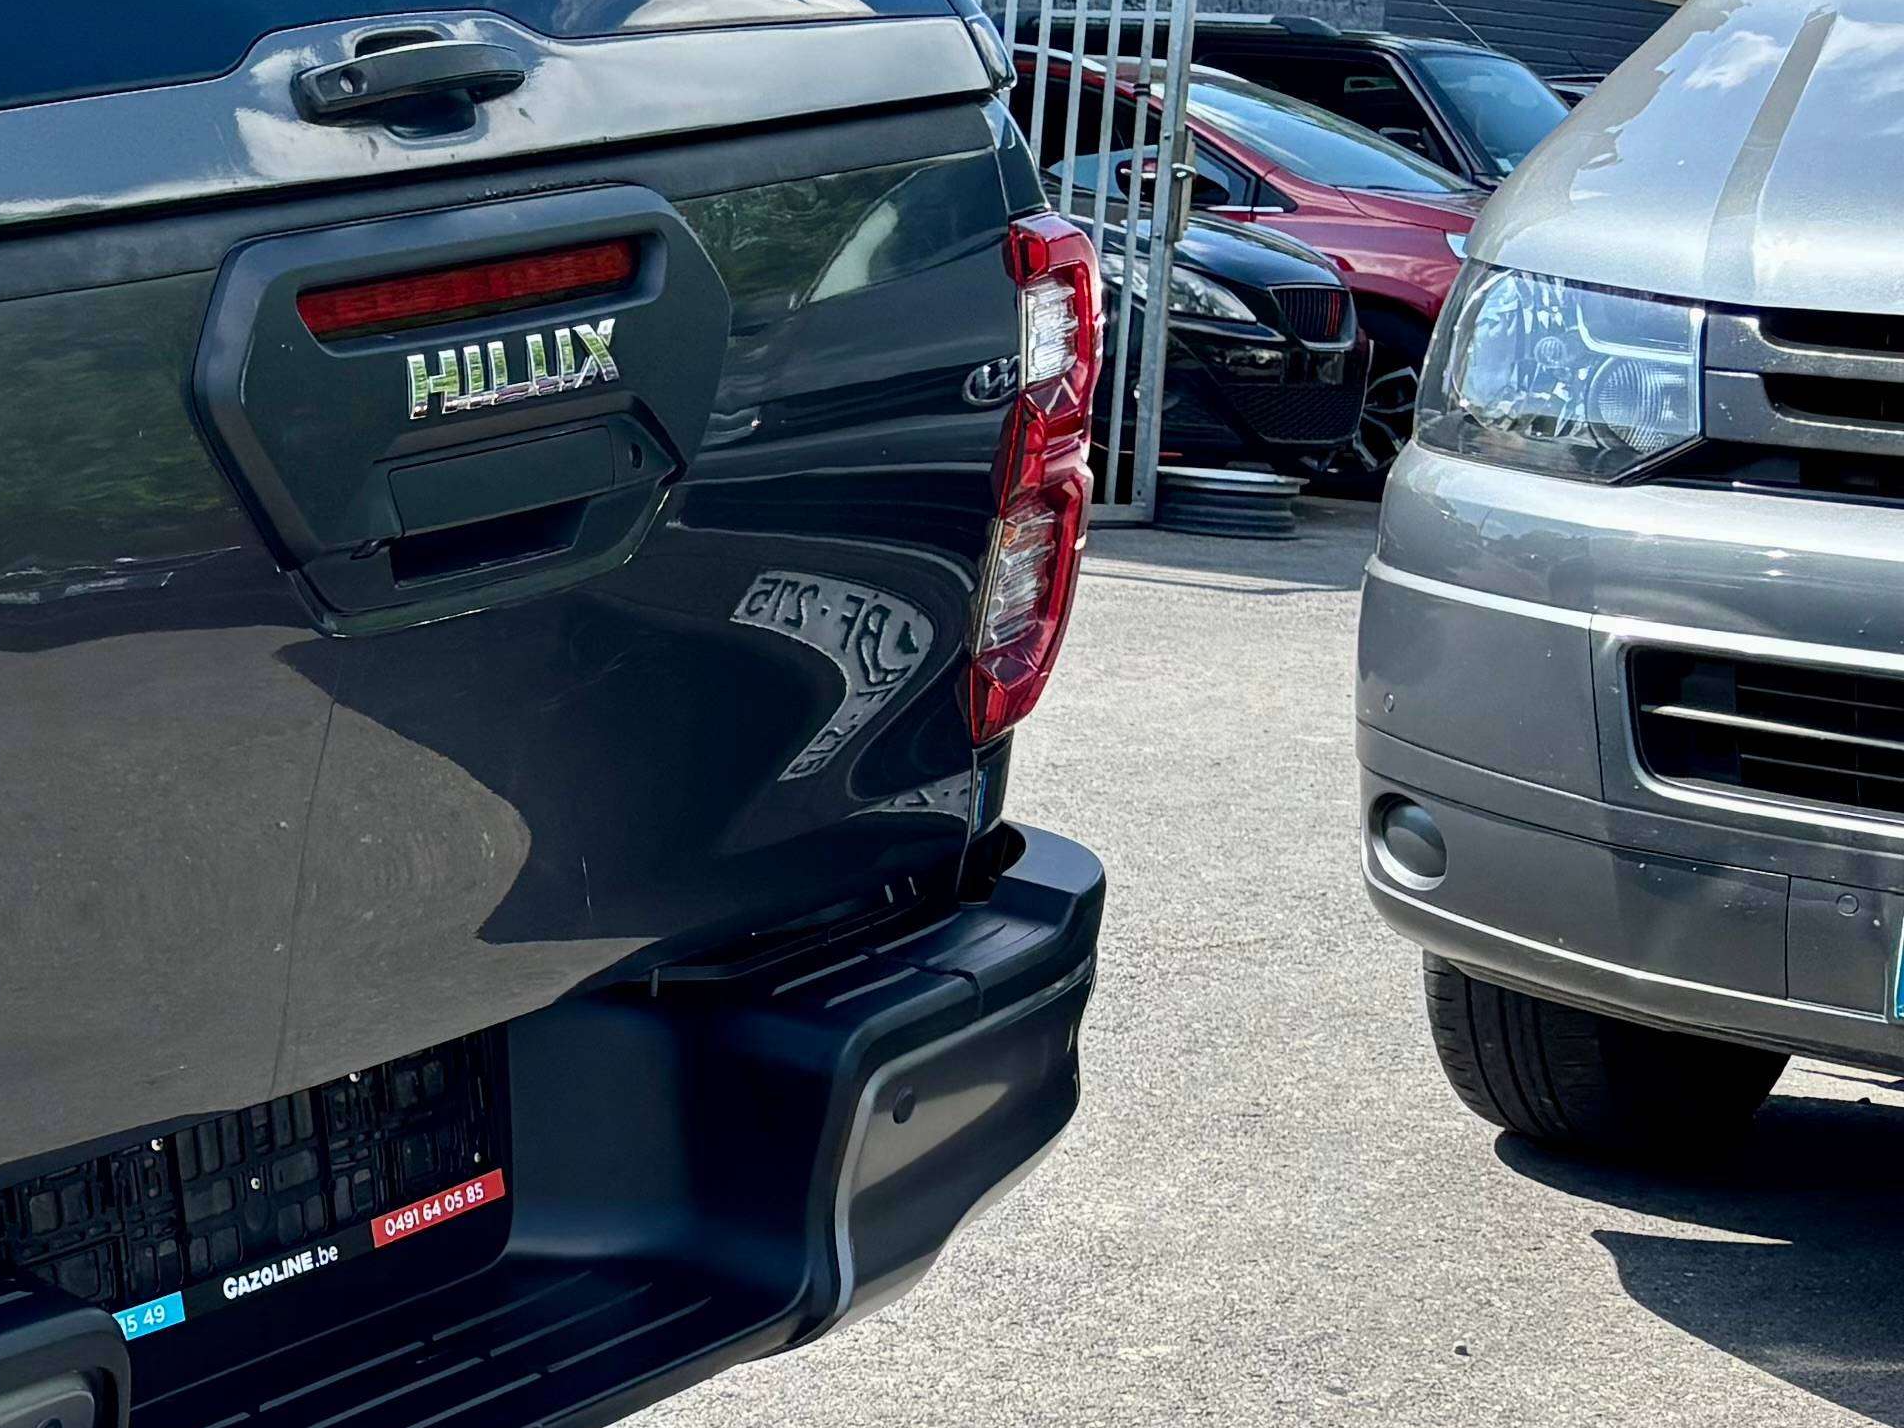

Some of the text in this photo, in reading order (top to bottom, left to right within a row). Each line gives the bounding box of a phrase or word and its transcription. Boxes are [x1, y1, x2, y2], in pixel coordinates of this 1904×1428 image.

[406, 318, 620, 420] HILUX
[384, 1182, 484, 1236] 0491 64 05 85
[223, 1245, 338, 1300] GAZOLINE.be
[143, 1304, 165, 1325] 49
